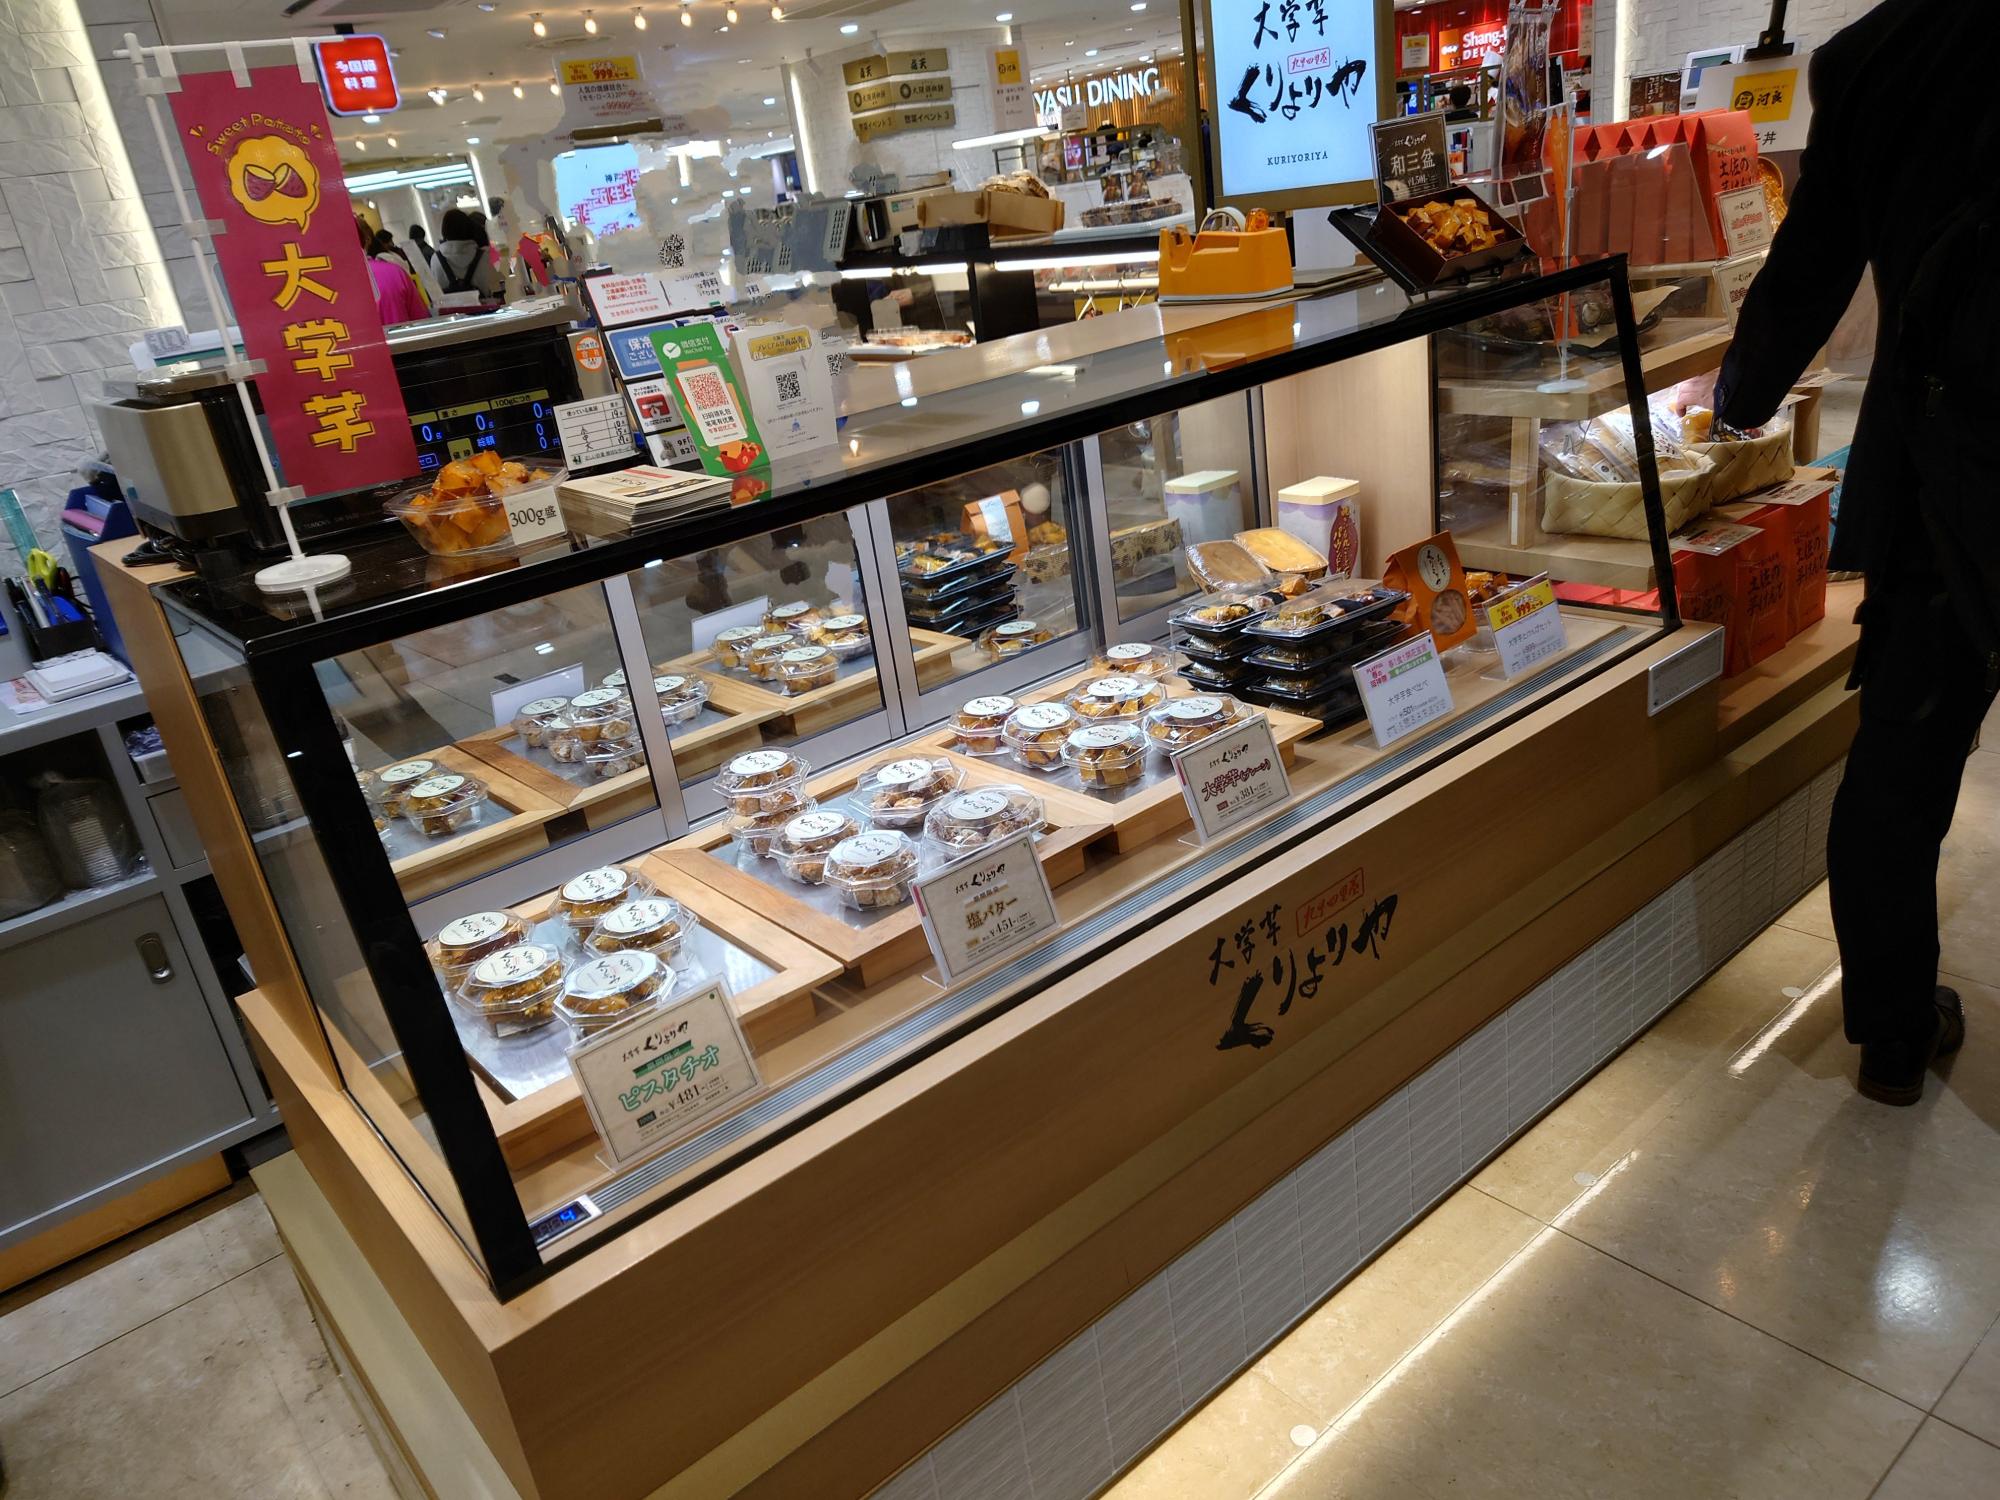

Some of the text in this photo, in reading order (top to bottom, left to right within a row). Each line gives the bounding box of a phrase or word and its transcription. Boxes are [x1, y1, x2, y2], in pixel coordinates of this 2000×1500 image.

[1253, 0, 1329, 49] 大学芋
[1088, 68, 1160, 107] DINING
[1227, 56, 1366, 124] くりよりや
[207, 113, 311, 155] Sweet Potato
[1267, 150, 1328, 166] KURIYORIYA
[1391, 147, 1436, 177] 和三盆
[261, 242, 376, 453] 大学芋
[509, 505, 557, 527] 300g盛
[966, 897, 1018, 930] 塩バター
[1209, 904, 1282, 986] 大学芋
[1216, 894, 1398, 1050] くりよりや
[643, 1020, 689, 1051] くりよりや
[619, 1045, 720, 1112] ピスタチオ
